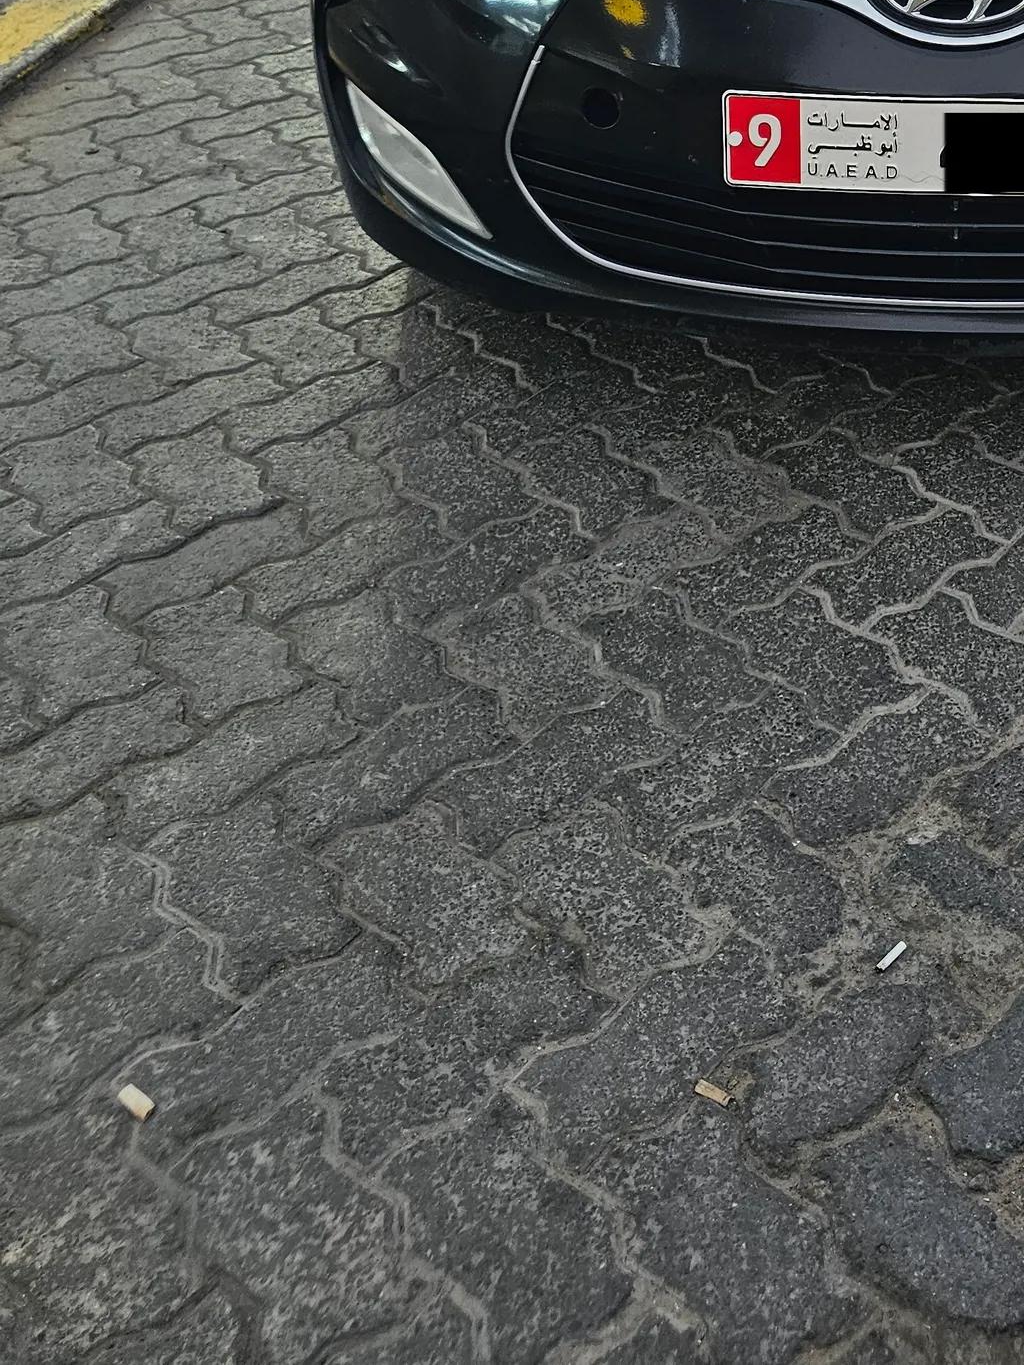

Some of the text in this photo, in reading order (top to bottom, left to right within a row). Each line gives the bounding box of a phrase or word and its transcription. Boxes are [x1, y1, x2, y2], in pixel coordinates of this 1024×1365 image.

[747, 112, 783, 168] 9
[806, 131, 899, 160] أبو ظبي
[865, 165, 898, 180] A.D
